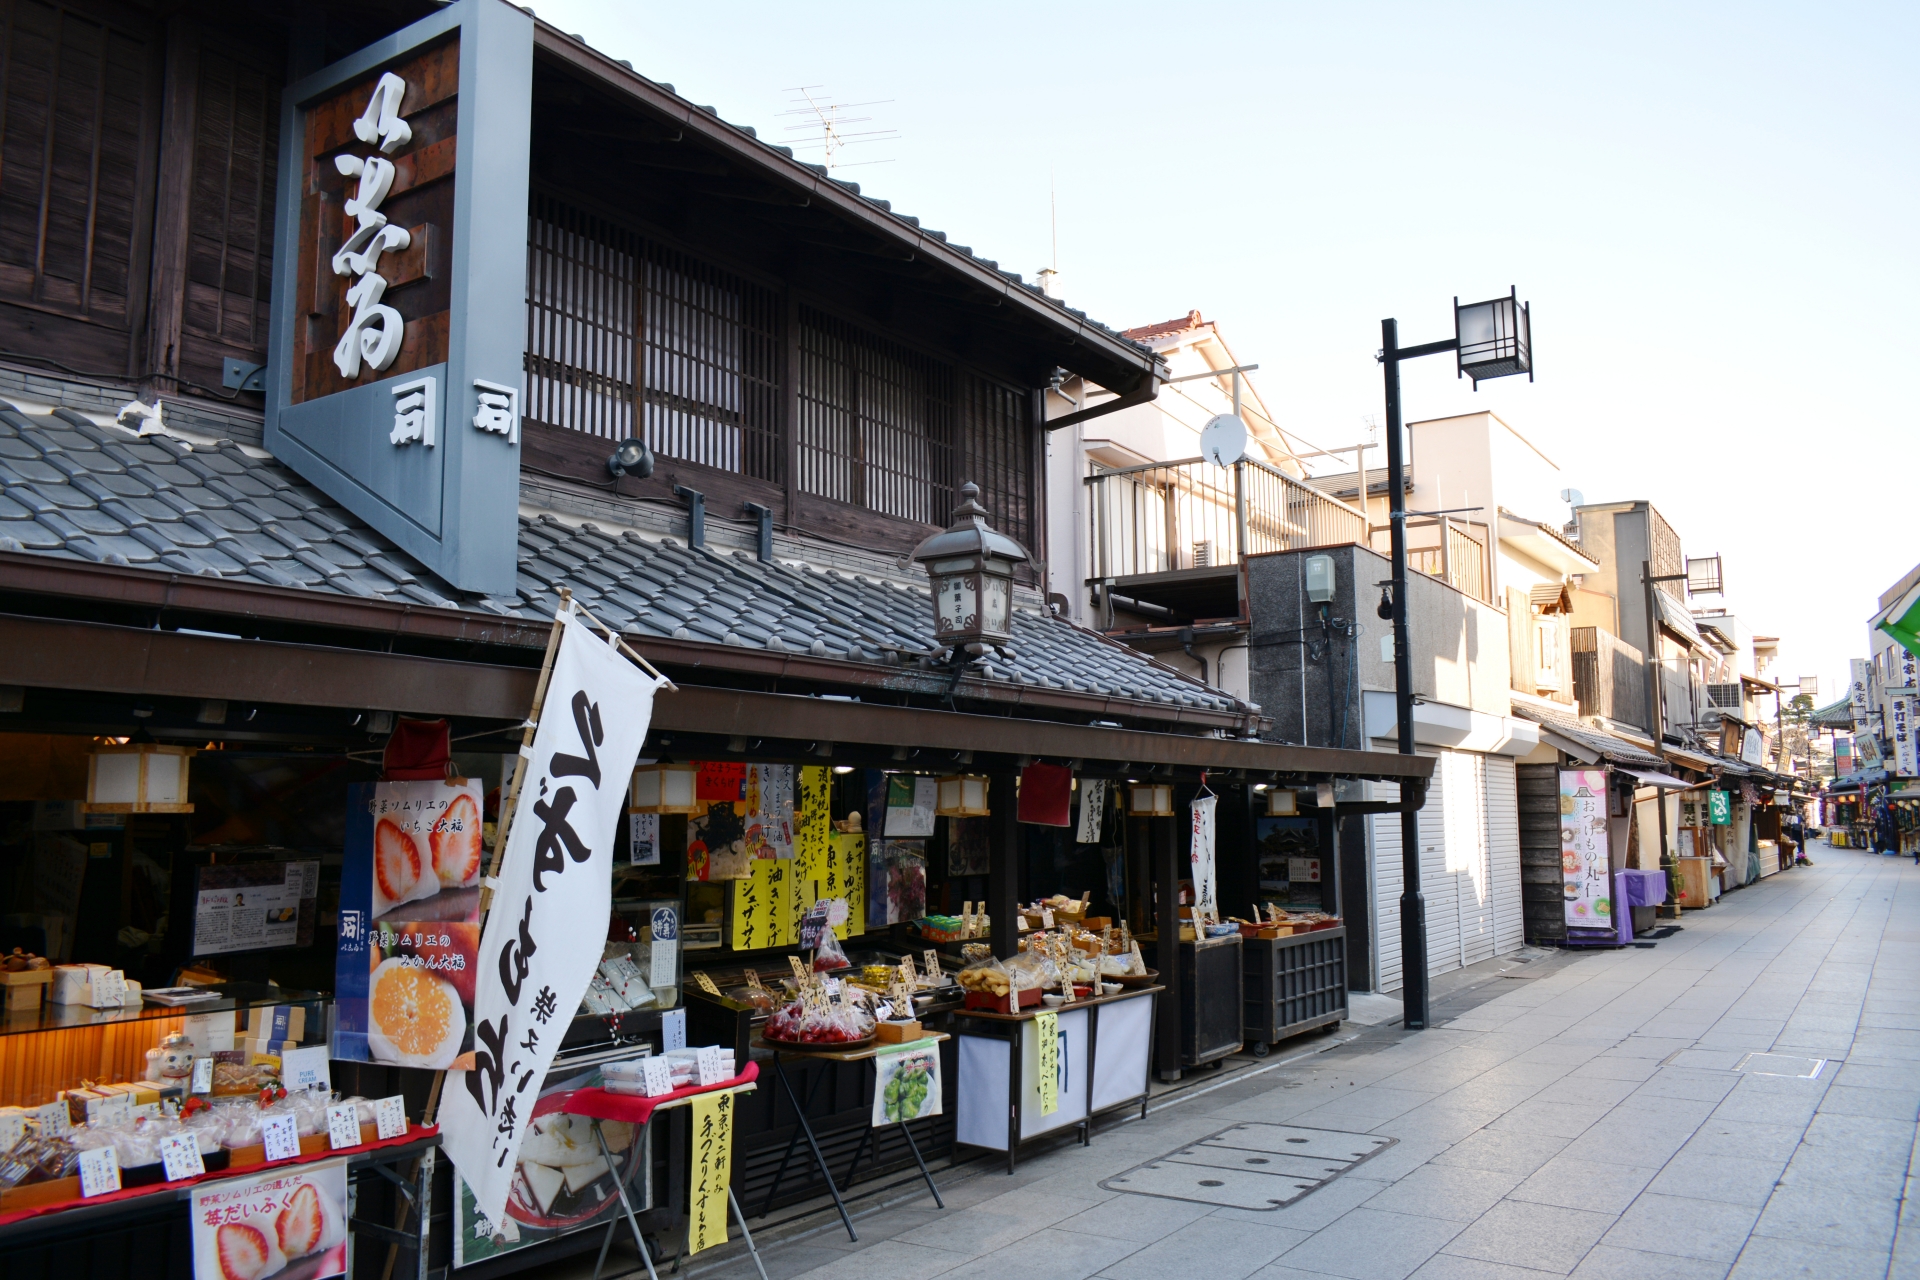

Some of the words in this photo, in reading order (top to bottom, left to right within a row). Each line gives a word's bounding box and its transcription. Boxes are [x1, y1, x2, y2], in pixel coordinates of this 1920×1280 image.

[953, 581, 963, 625] 御菓子司
[1893, 700, 1907, 743] 手打そば
[705, 776, 736, 788] きくらげ
[749, 767, 758, 818] おすすめ
[368, 799, 449, 816] 野菜ソムリエの
[762, 765, 772, 839] きくらげ
[773, 778, 783, 843] ごまラー油
[400, 818, 464, 834] いちご大福
[1583, 800, 1600, 898] おつけもの丸仁
[368, 930, 450, 947] 野菜ソムリエの
[400, 954, 466, 971] みかん大福
[297, 1075, 317, 1085] CREAM
[299, 1069, 315, 1078] PURE
[906, 1060, 936, 1073] ザーサイ
[713, 1093, 730, 1194] 東京で二軒のみ
[199, 1174, 303, 1207] 野菜ソムリエの選んだ
[695, 1114, 716, 1252] 手づくりくずもちの店
[203, 1191, 292, 1227] 苺だいふく
